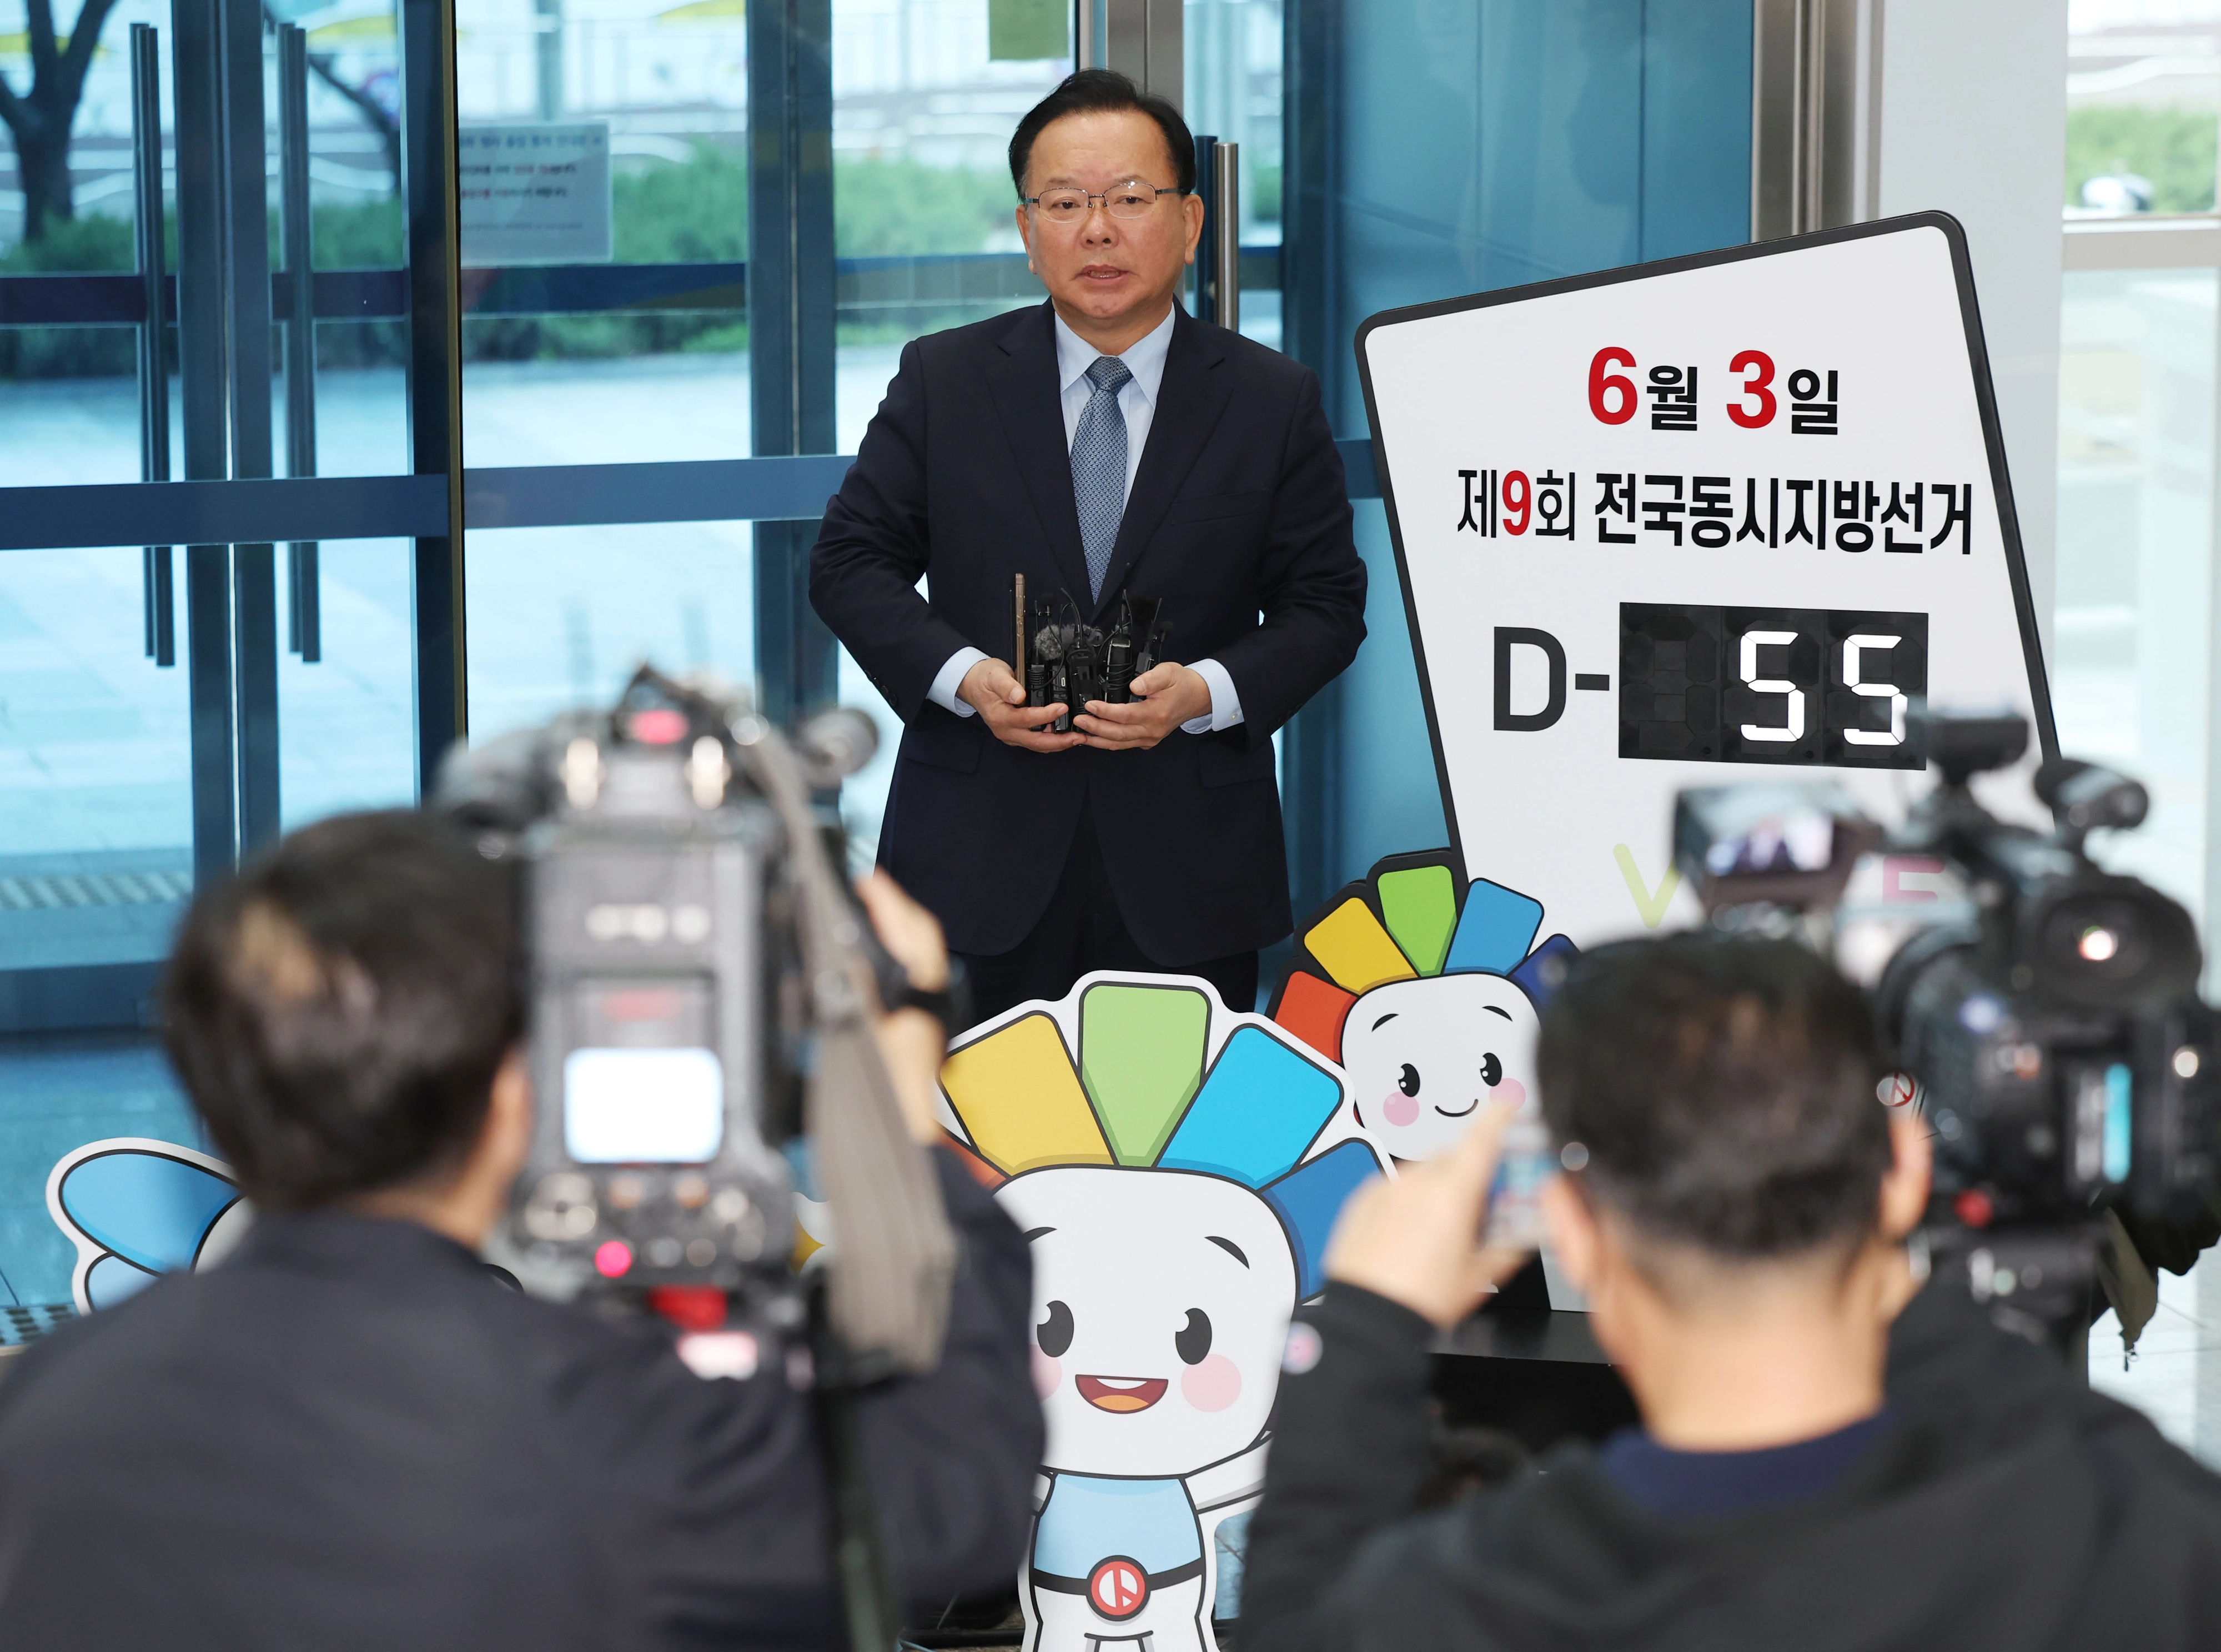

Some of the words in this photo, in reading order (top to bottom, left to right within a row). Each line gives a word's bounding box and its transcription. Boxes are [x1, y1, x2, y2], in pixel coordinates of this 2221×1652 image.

[1588, 347, 1698, 431] 6월
[1726, 350, 1838, 435] 3일
[1457, 469, 1575, 541] 제9회
[1595, 473, 1972, 555] 전국동시지방선거
